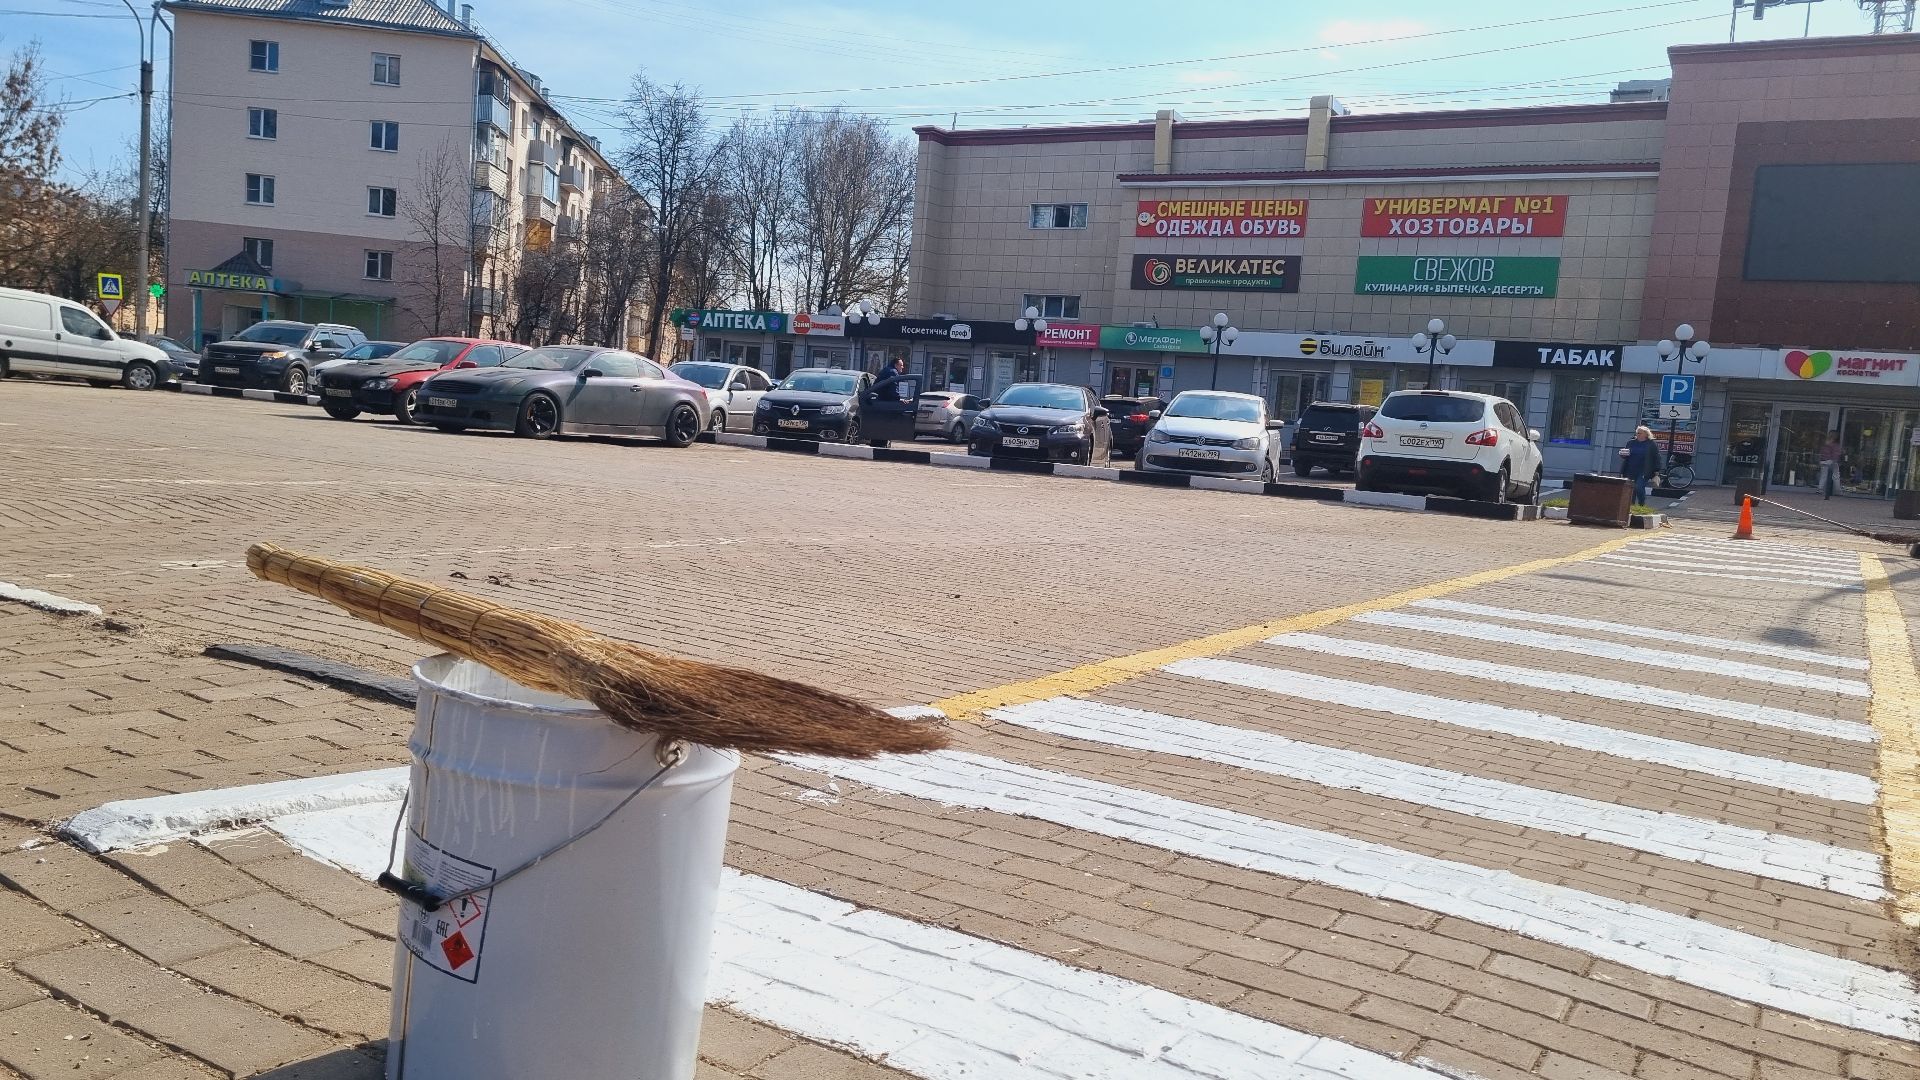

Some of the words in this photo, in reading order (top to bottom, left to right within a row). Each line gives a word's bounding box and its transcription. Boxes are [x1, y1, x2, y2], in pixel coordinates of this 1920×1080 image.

[1157, 201, 1245, 217] СМЕШНЫЕ
[1250, 200, 1304, 218] ЦЕНЫ
[1374, 197, 1506, 215] УНИВЕРМАГ
[1514, 196, 1554, 214] №1
[1155, 219, 1235, 237] ОДЕЖДА
[1240, 219, 1301, 235] ОБУВЬ
[1388, 218, 1533, 235] ХОЗТОВАРЫ
[1175, 258, 1286, 275] ВЕЛИКАТЕС
[1413, 257, 1495, 282] СВЕЖОВ
[189, 271, 269, 290] АПТЕКА
[1185, 277, 1231, 286] правильные
[1233, 278, 1271, 287] продукты
[1364, 283, 1430, 293] КУЛИНАРИЯ
[1434, 284, 1487, 294] ВЫПЕЧКА
[1491, 285, 1544, 295] ДЕСЕРТЫ
[702, 312, 767, 330] АПТЕКА
[901, 325, 948, 336] Косметичка
[1044, 328, 1092, 340] РЕМОНТ
[1320, 339, 1385, 358] Билайн
[1537, 347, 1615, 367] ТАБАК
[1733, 455, 1759, 464] TELE2
